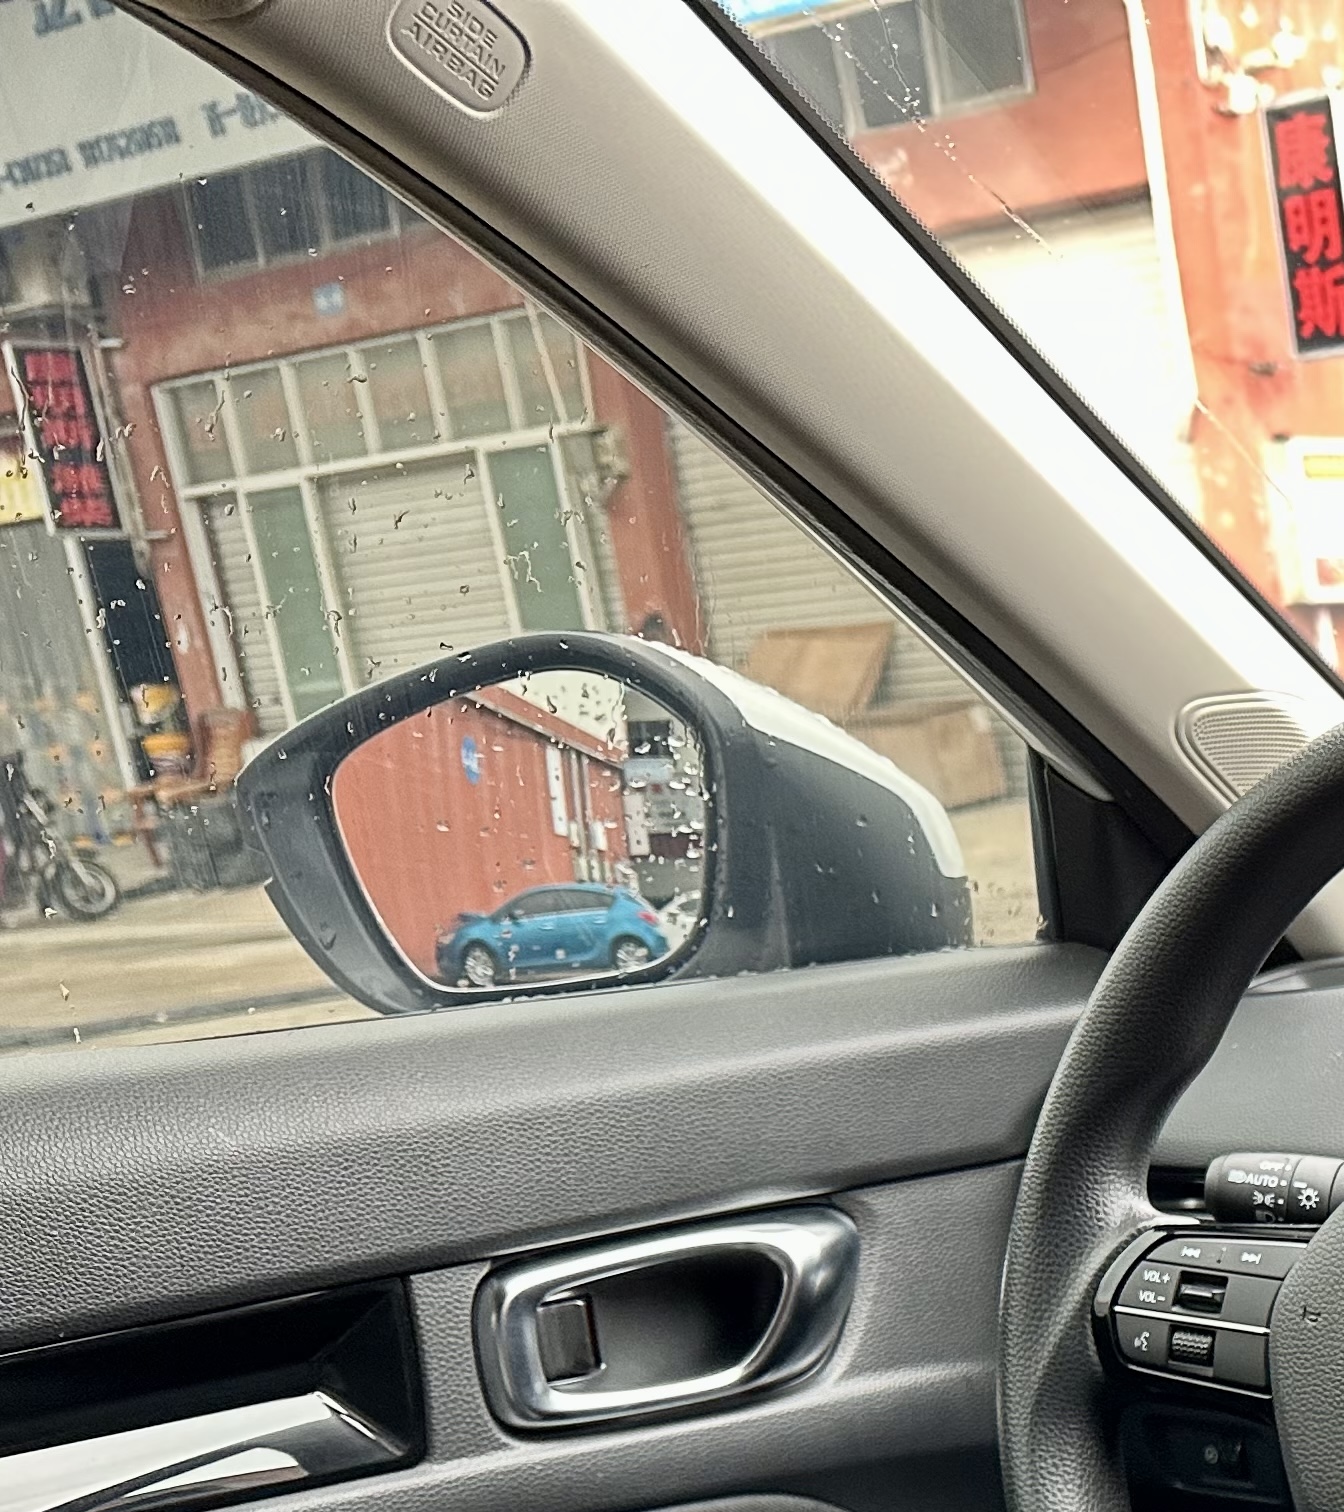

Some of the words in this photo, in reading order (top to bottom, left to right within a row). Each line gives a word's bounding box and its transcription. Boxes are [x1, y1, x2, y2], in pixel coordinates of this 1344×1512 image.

[420, 1, 506, 77] CURTAIN
[447, 1, 498, 49] SIDE
[403, 21, 496, 100] AIRBAG
[1246, 1173, 1278, 1188] AUTO
